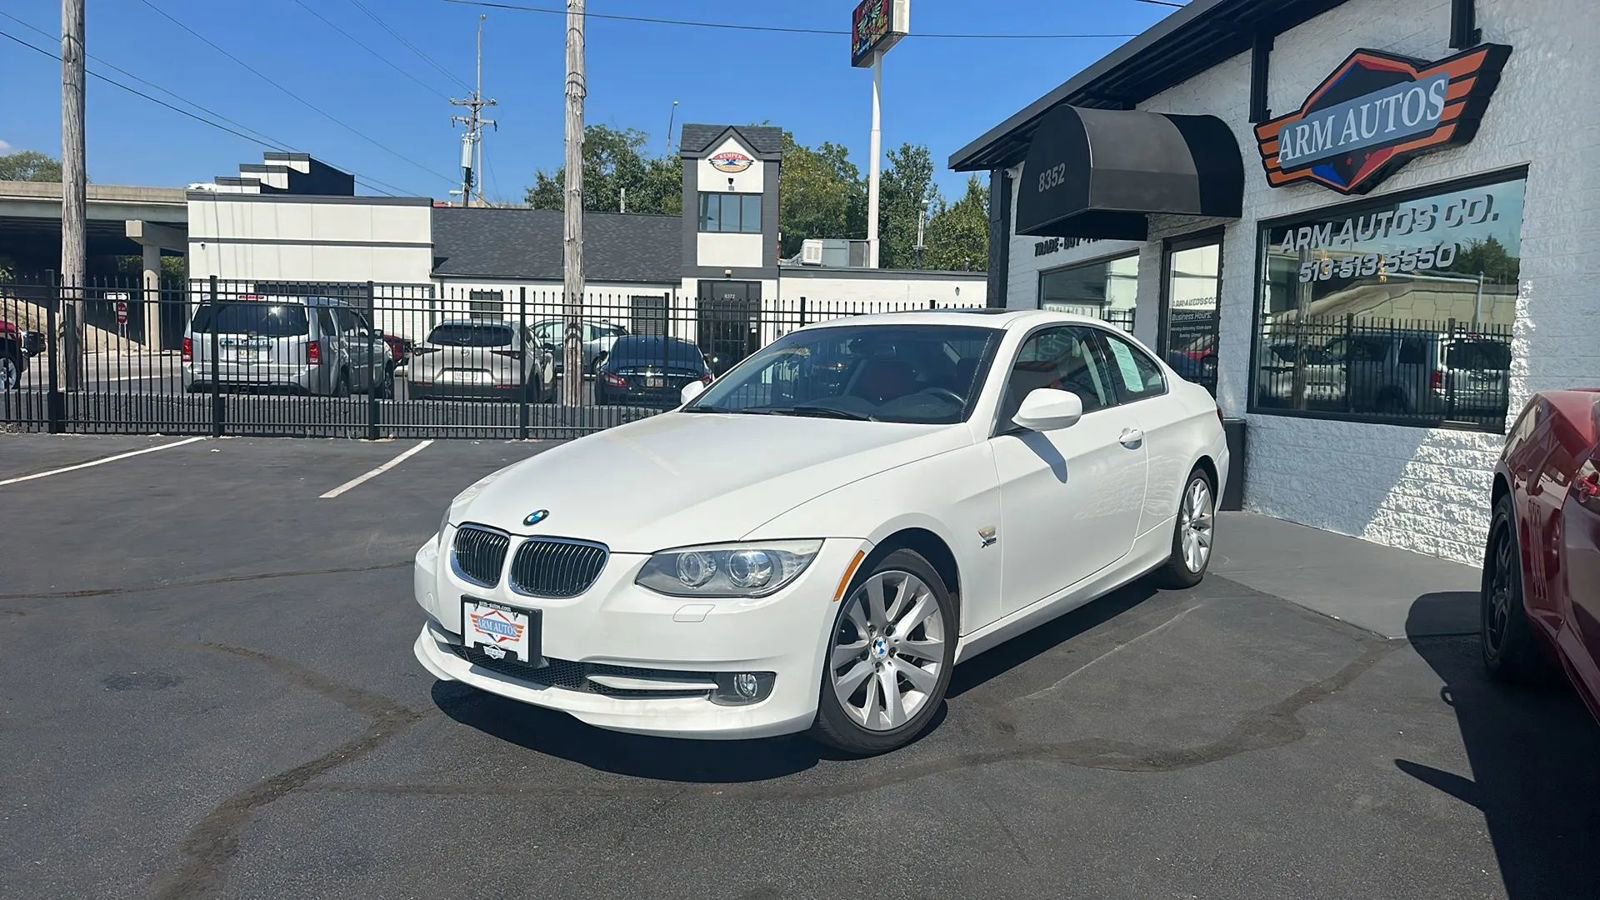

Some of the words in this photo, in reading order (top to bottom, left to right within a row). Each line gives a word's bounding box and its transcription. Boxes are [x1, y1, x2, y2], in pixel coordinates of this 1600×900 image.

[1276, 114, 1336, 163] ARM
[1338, 79, 1445, 145] AUTOS
[1038, 162, 1066, 193] 8352
[1281, 222, 1333, 254] ARM
[1338, 204, 1438, 245] AUTOS
[1034, 237, 1060, 257] TRADE
[494, 621, 517, 637] AUTOS
